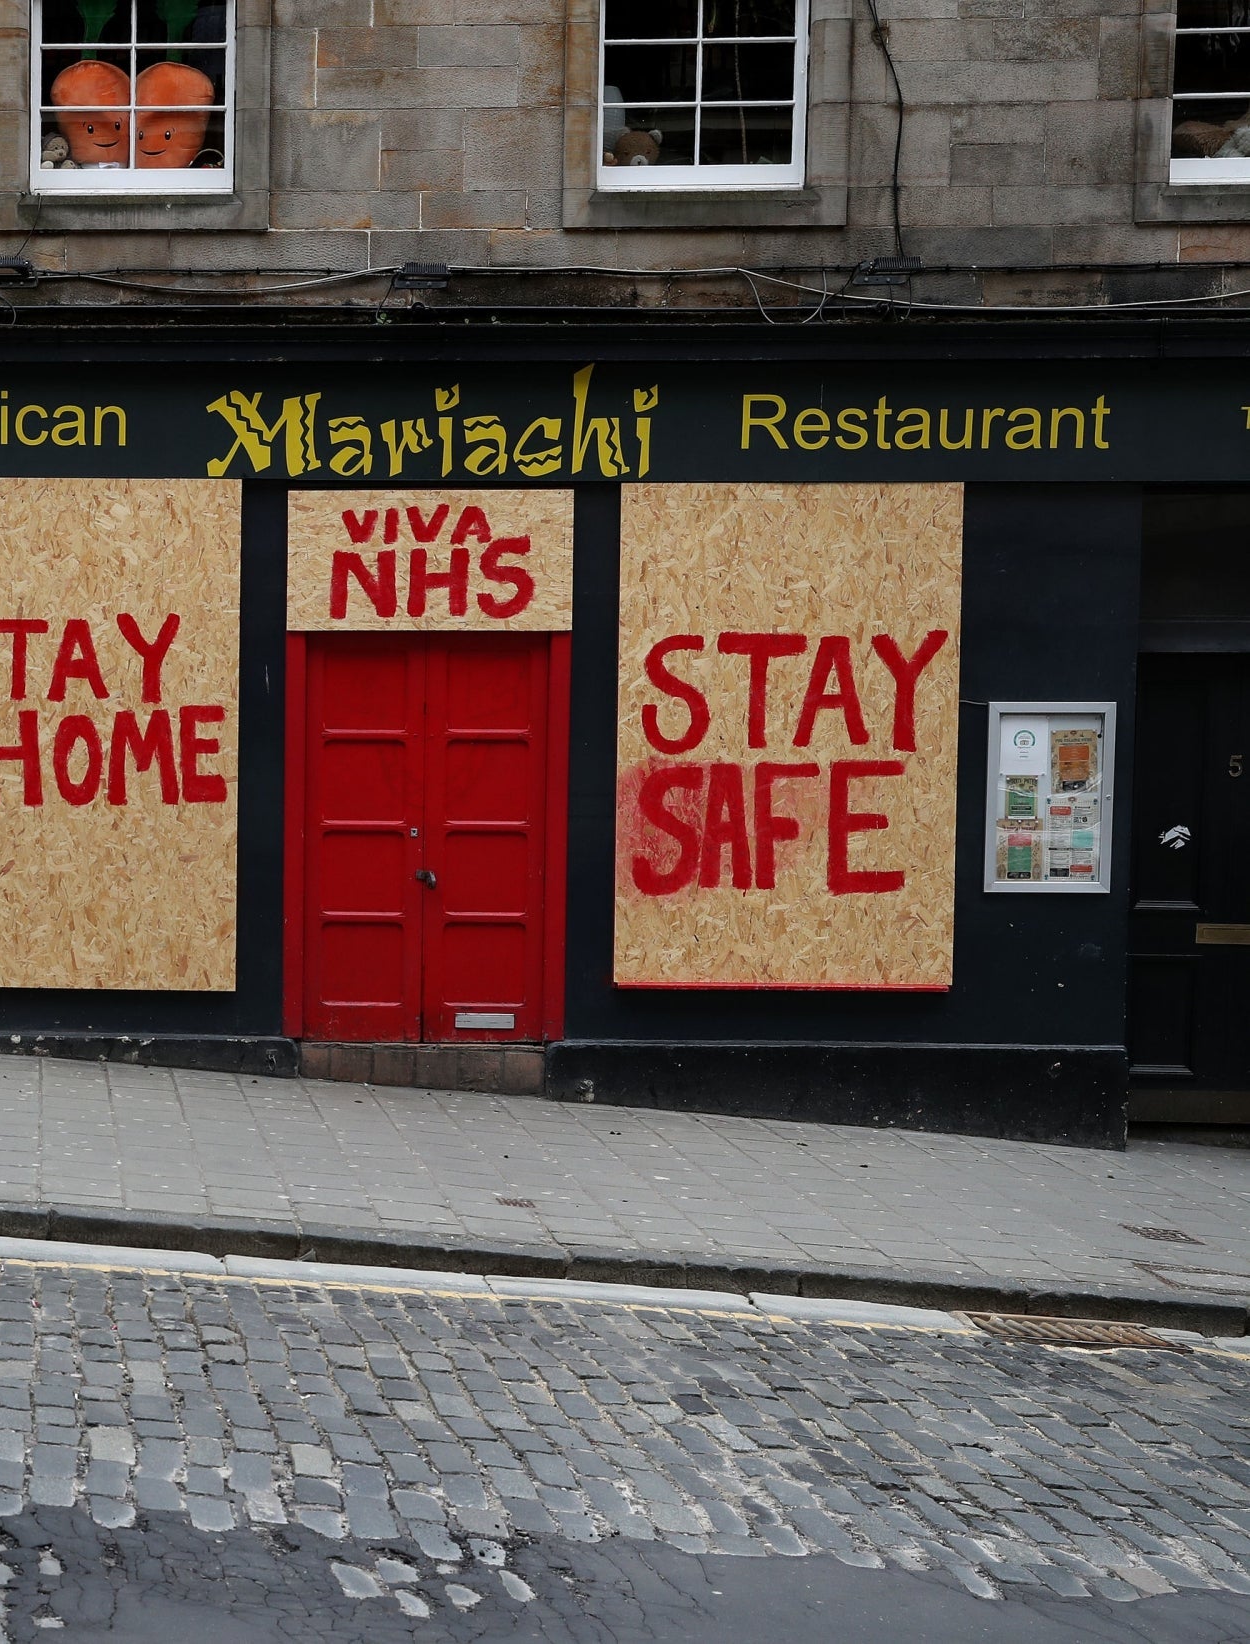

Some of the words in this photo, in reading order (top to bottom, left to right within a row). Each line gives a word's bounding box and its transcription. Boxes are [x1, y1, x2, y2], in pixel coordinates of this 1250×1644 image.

[206, 363, 659, 478] Mariachi
[741, 394, 1111, 450] Restaurant
[341, 503, 492, 544] VIVA
[329, 535, 535, 619] NHS
[641, 630, 949, 755] STAY
[1228, 754, 1243, 777] 5
[631, 757, 906, 896] SAFE
